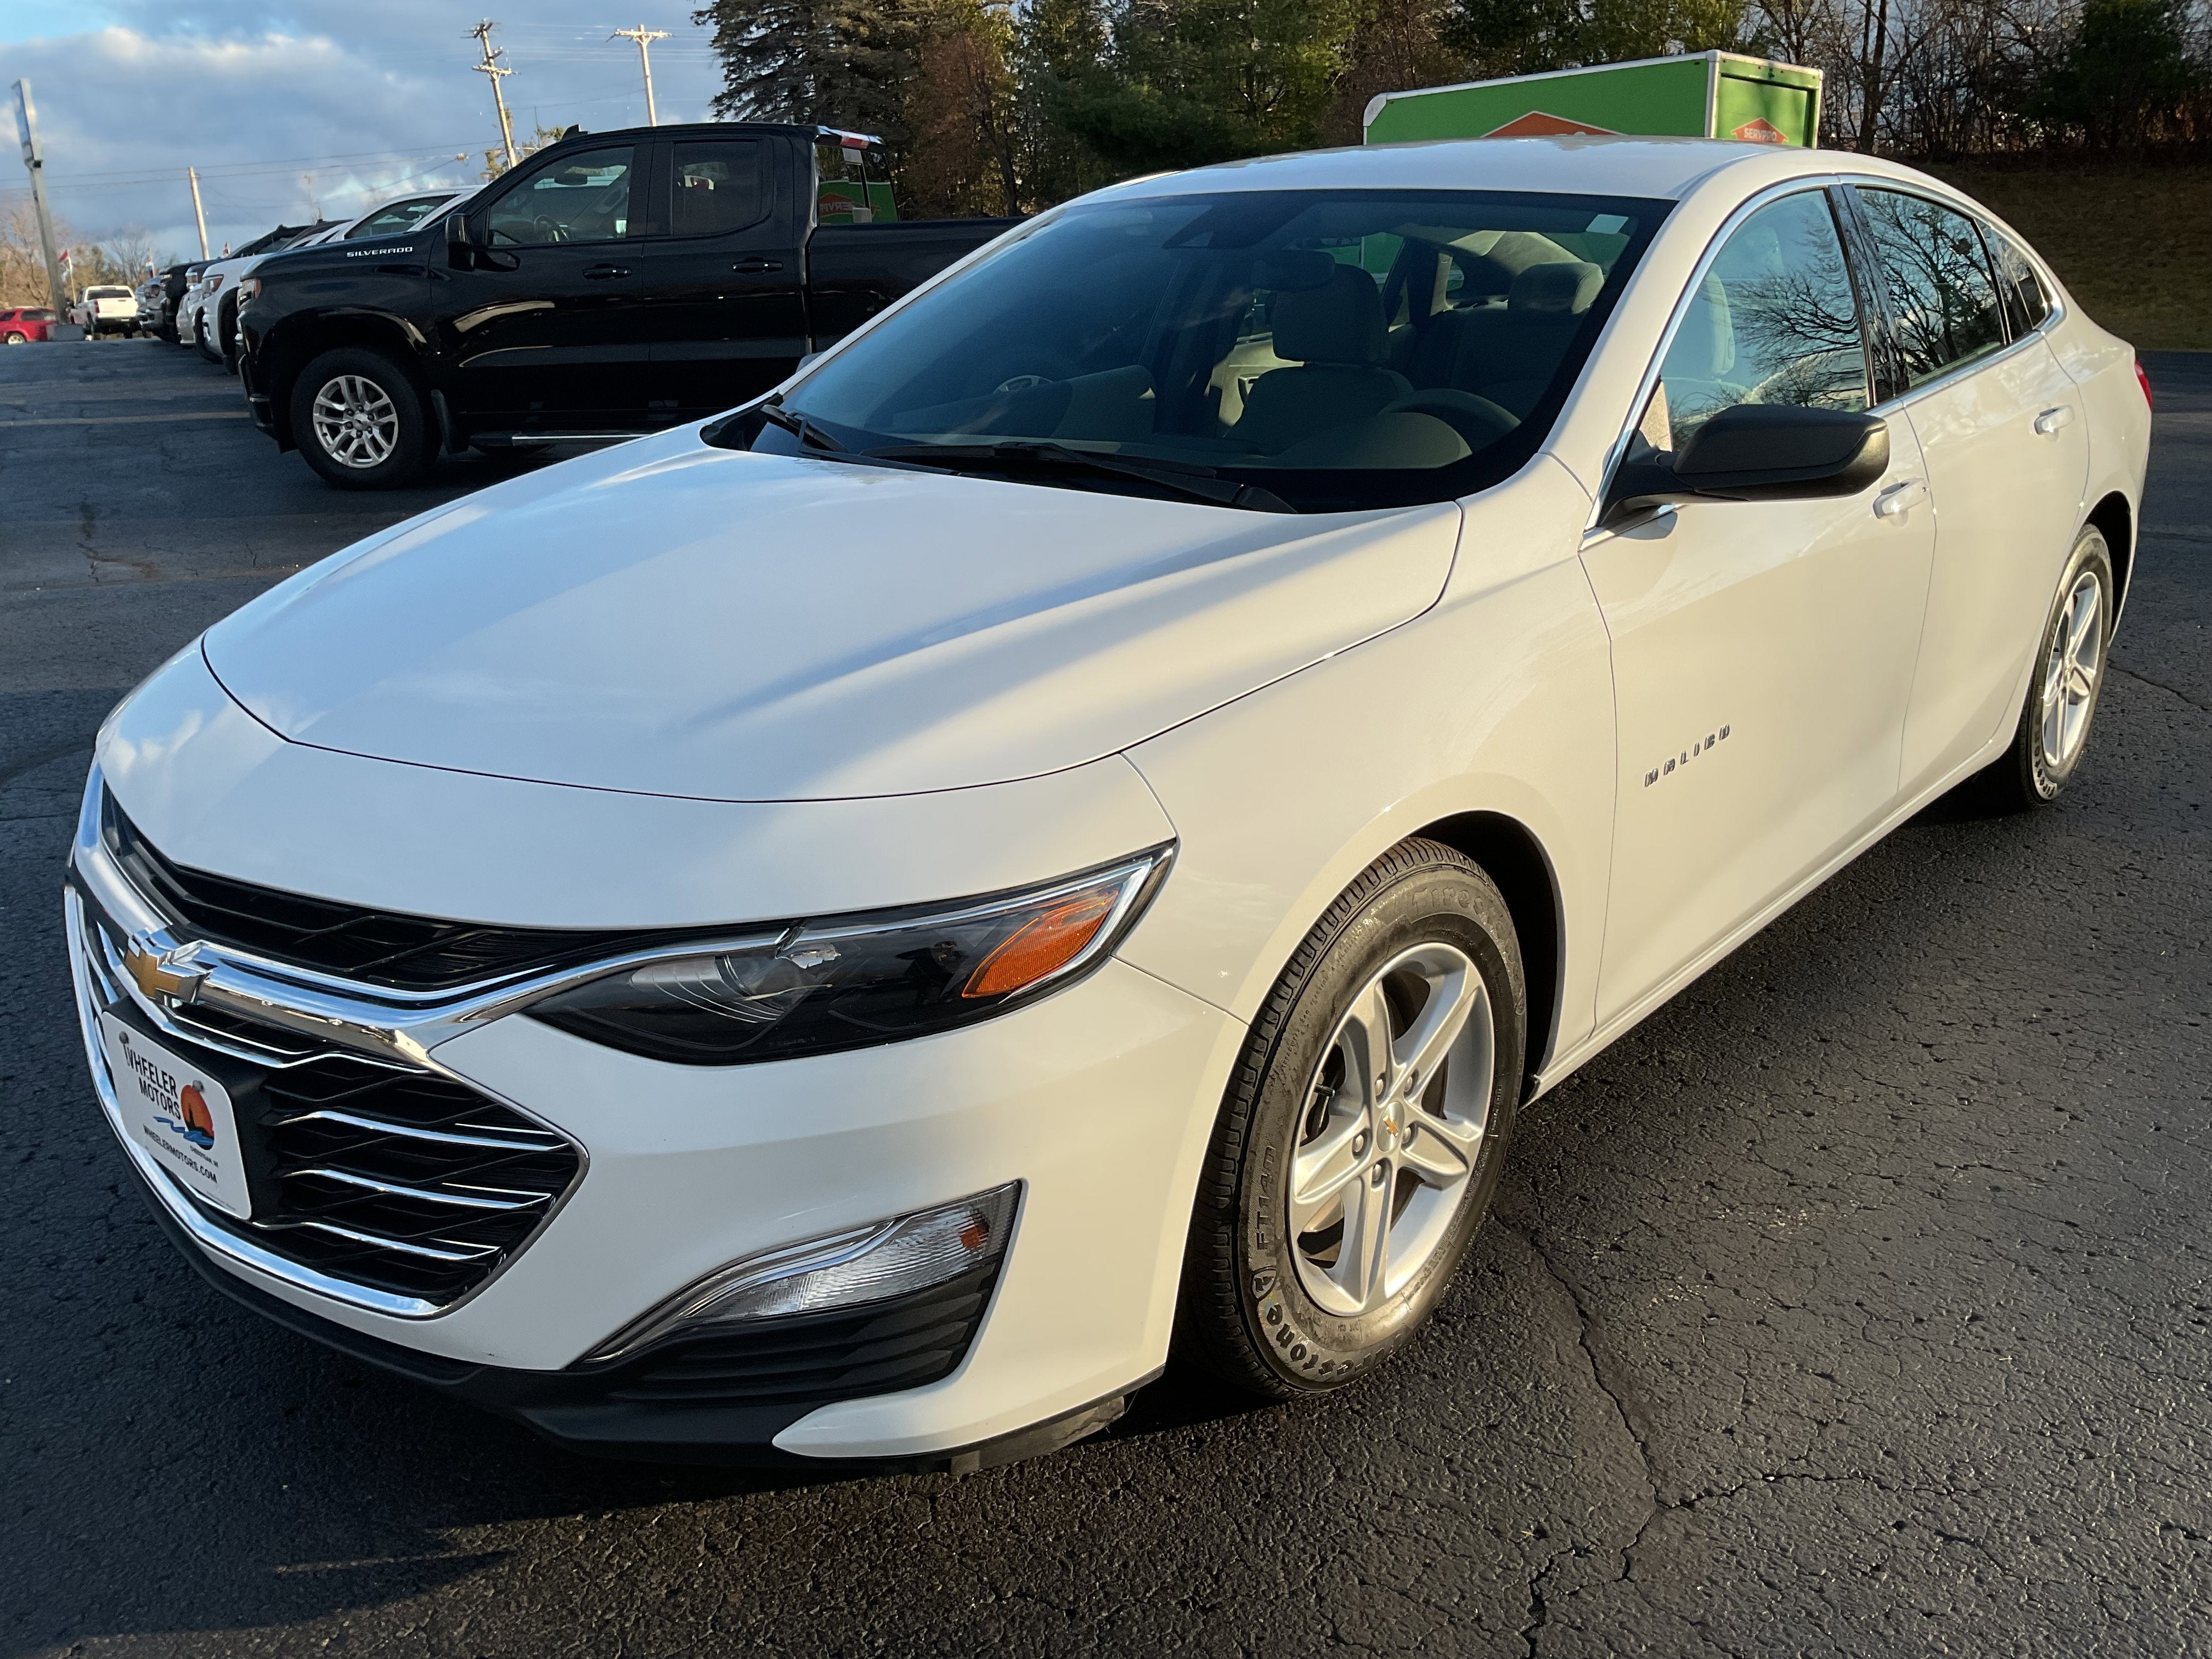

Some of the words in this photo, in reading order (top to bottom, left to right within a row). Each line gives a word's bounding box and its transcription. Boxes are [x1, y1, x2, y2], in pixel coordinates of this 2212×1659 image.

[1743, 127, 1777, 142] SERVPRO
[346, 246, 413, 257] SILVERADO
[1644, 723, 1730, 788] MALIBU
[123, 1044, 178, 1099] WHEELER
[138, 1076, 181, 1120] MOTORS
[143, 1124, 218, 1184] WHEELERMOTORS.COM
